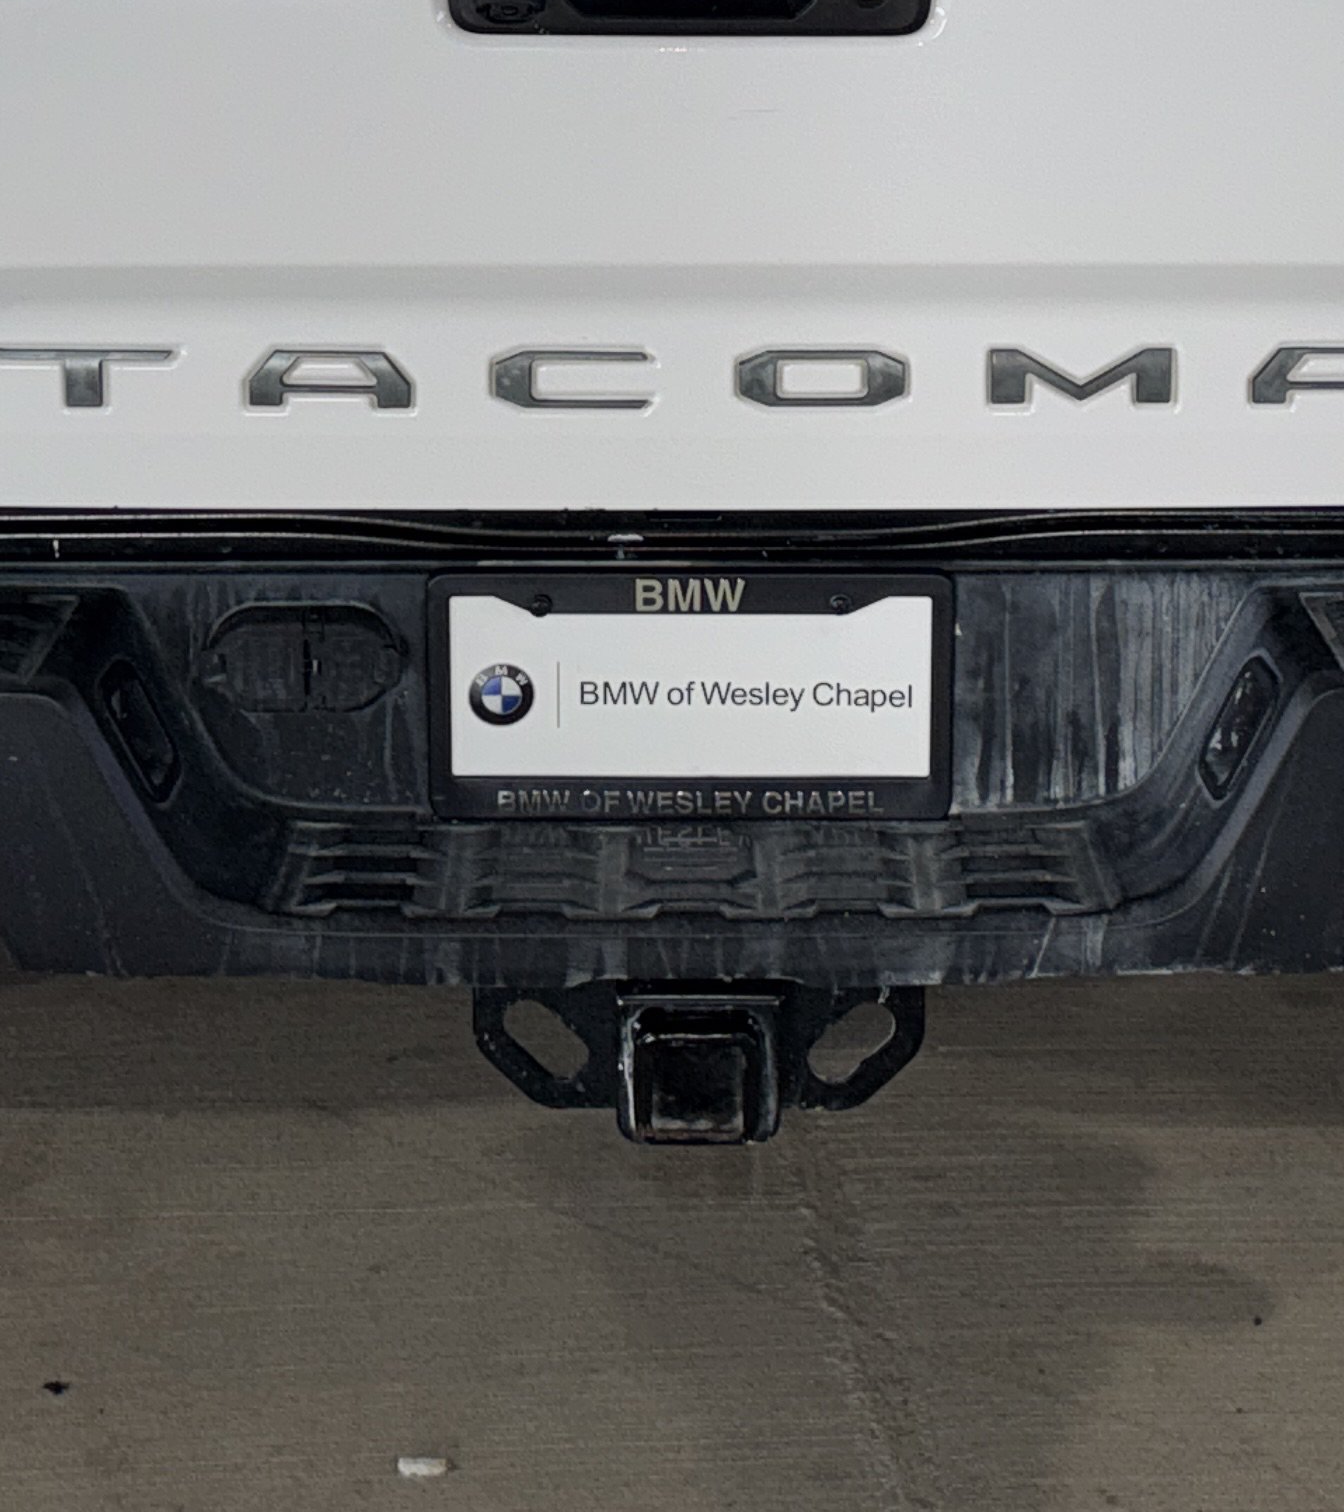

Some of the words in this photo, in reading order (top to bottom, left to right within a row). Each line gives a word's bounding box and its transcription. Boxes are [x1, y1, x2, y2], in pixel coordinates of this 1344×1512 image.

[634, 577, 746, 613] BMW
[579, 681, 659, 705] BMW
[667, 681, 696, 706] of
[702, 682, 805, 713] Wesley
[812, 682, 913, 713] Chapel
[497, 790, 571, 812] BMW
[579, 790, 621, 813] OF
[627, 790, 753, 815] WESLEY
[761, 790, 885, 816] CHAPEL
